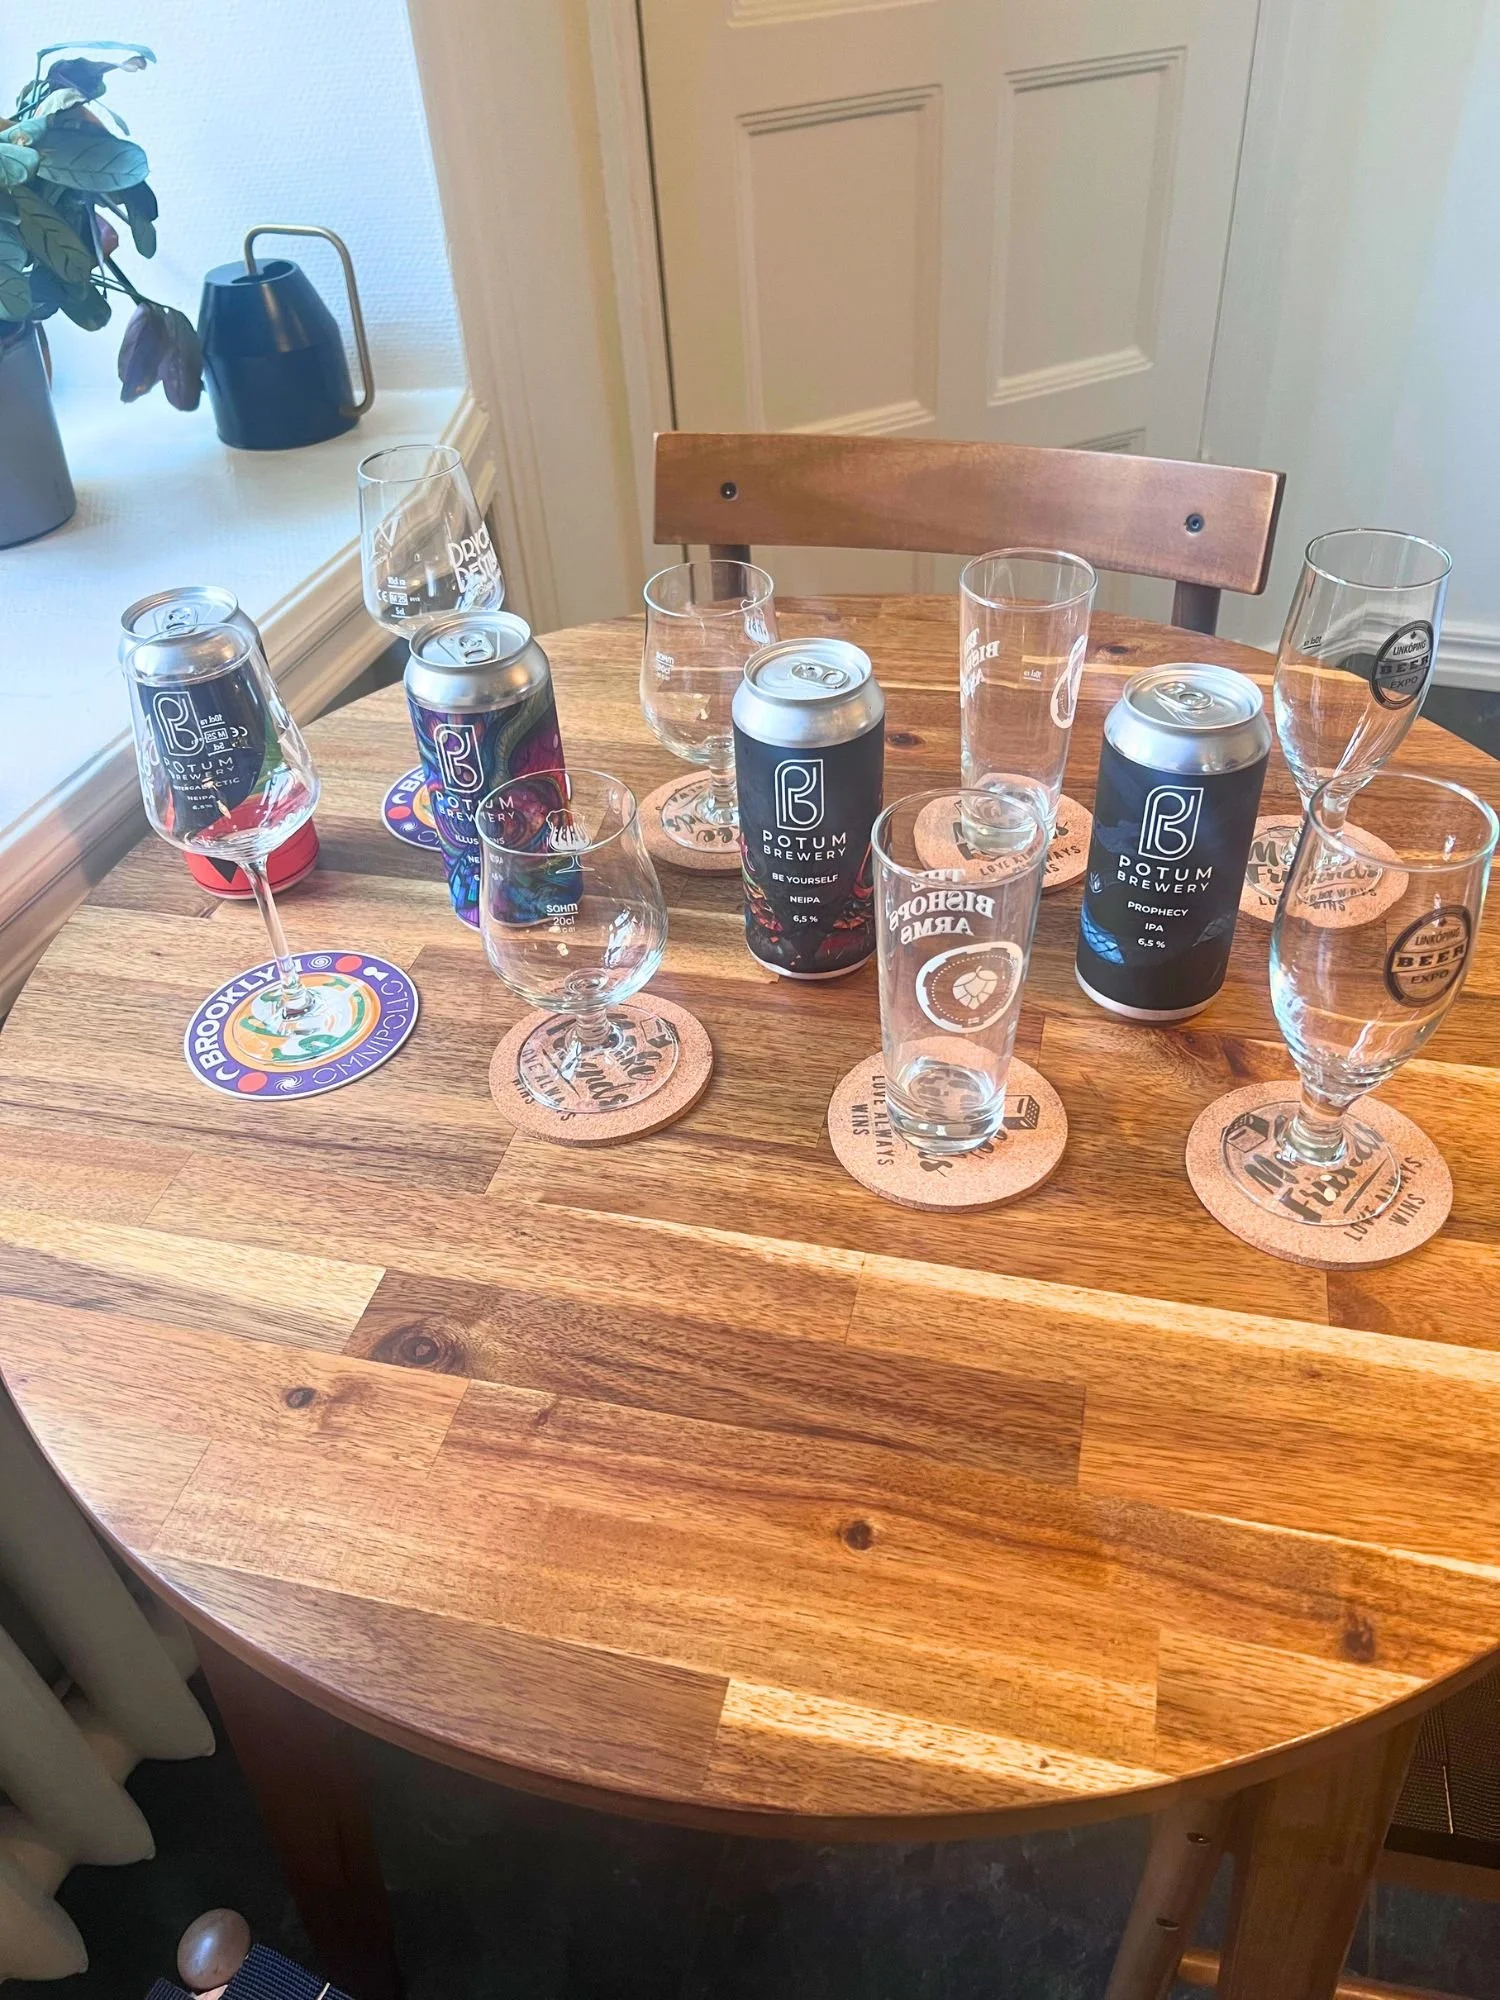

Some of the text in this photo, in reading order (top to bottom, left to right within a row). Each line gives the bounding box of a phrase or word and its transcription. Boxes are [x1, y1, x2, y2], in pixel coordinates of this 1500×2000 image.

[1379, 656, 1429, 675] BEER
[1390, 676, 1418, 689] EXPO
[163, 756, 233, 774] POTUM
[436, 790, 515, 812] POTUM
[762, 829, 847, 849] POTUM
[763, 844, 847, 861] BREWERY
[1118, 854, 1213, 881] POTUM
[772, 872, 839, 885] BE YOURSELF
[1117, 870, 1209, 894] BREWERY
[789, 895, 820, 904] NEIPA
[1127, 901, 1189, 917] PROPHECY
[553, 916, 575, 926] 20cl
[1145, 922, 1164, 932] IPA
[1396, 945, 1466, 967] BEER
[1410, 969, 1449, 985] EXPO
[851, 1103, 869, 1136] WINS
[874, 1112, 895, 1167] ALWAYS
[1388, 1192, 1427, 1228] WINS
